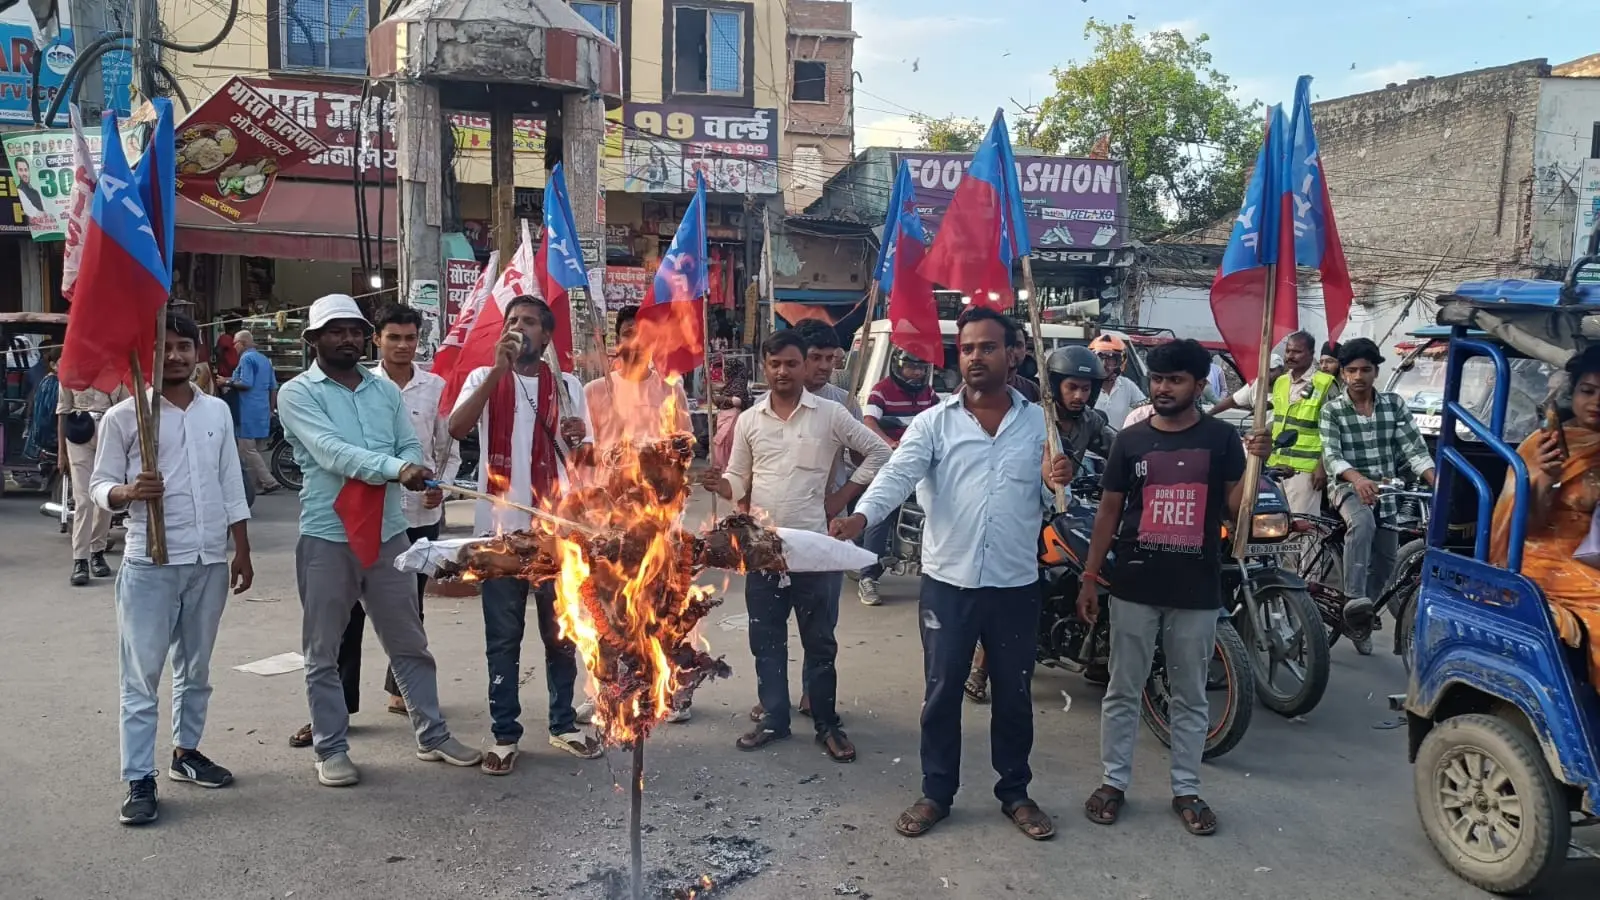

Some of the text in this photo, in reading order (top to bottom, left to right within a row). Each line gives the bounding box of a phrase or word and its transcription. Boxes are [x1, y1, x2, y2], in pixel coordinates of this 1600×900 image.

[227, 81, 326, 155] भारत जलपान
[701, 110, 771, 140] वर्ल्ड
[230, 113, 293, 156] भोजनालय
[1069, 209, 1112, 220] RELAXO
[1135, 460, 1148, 477] 09
[1155, 488, 1196, 500] BORN TO BE
[1139, 533, 1204, 554] EXPLORER
